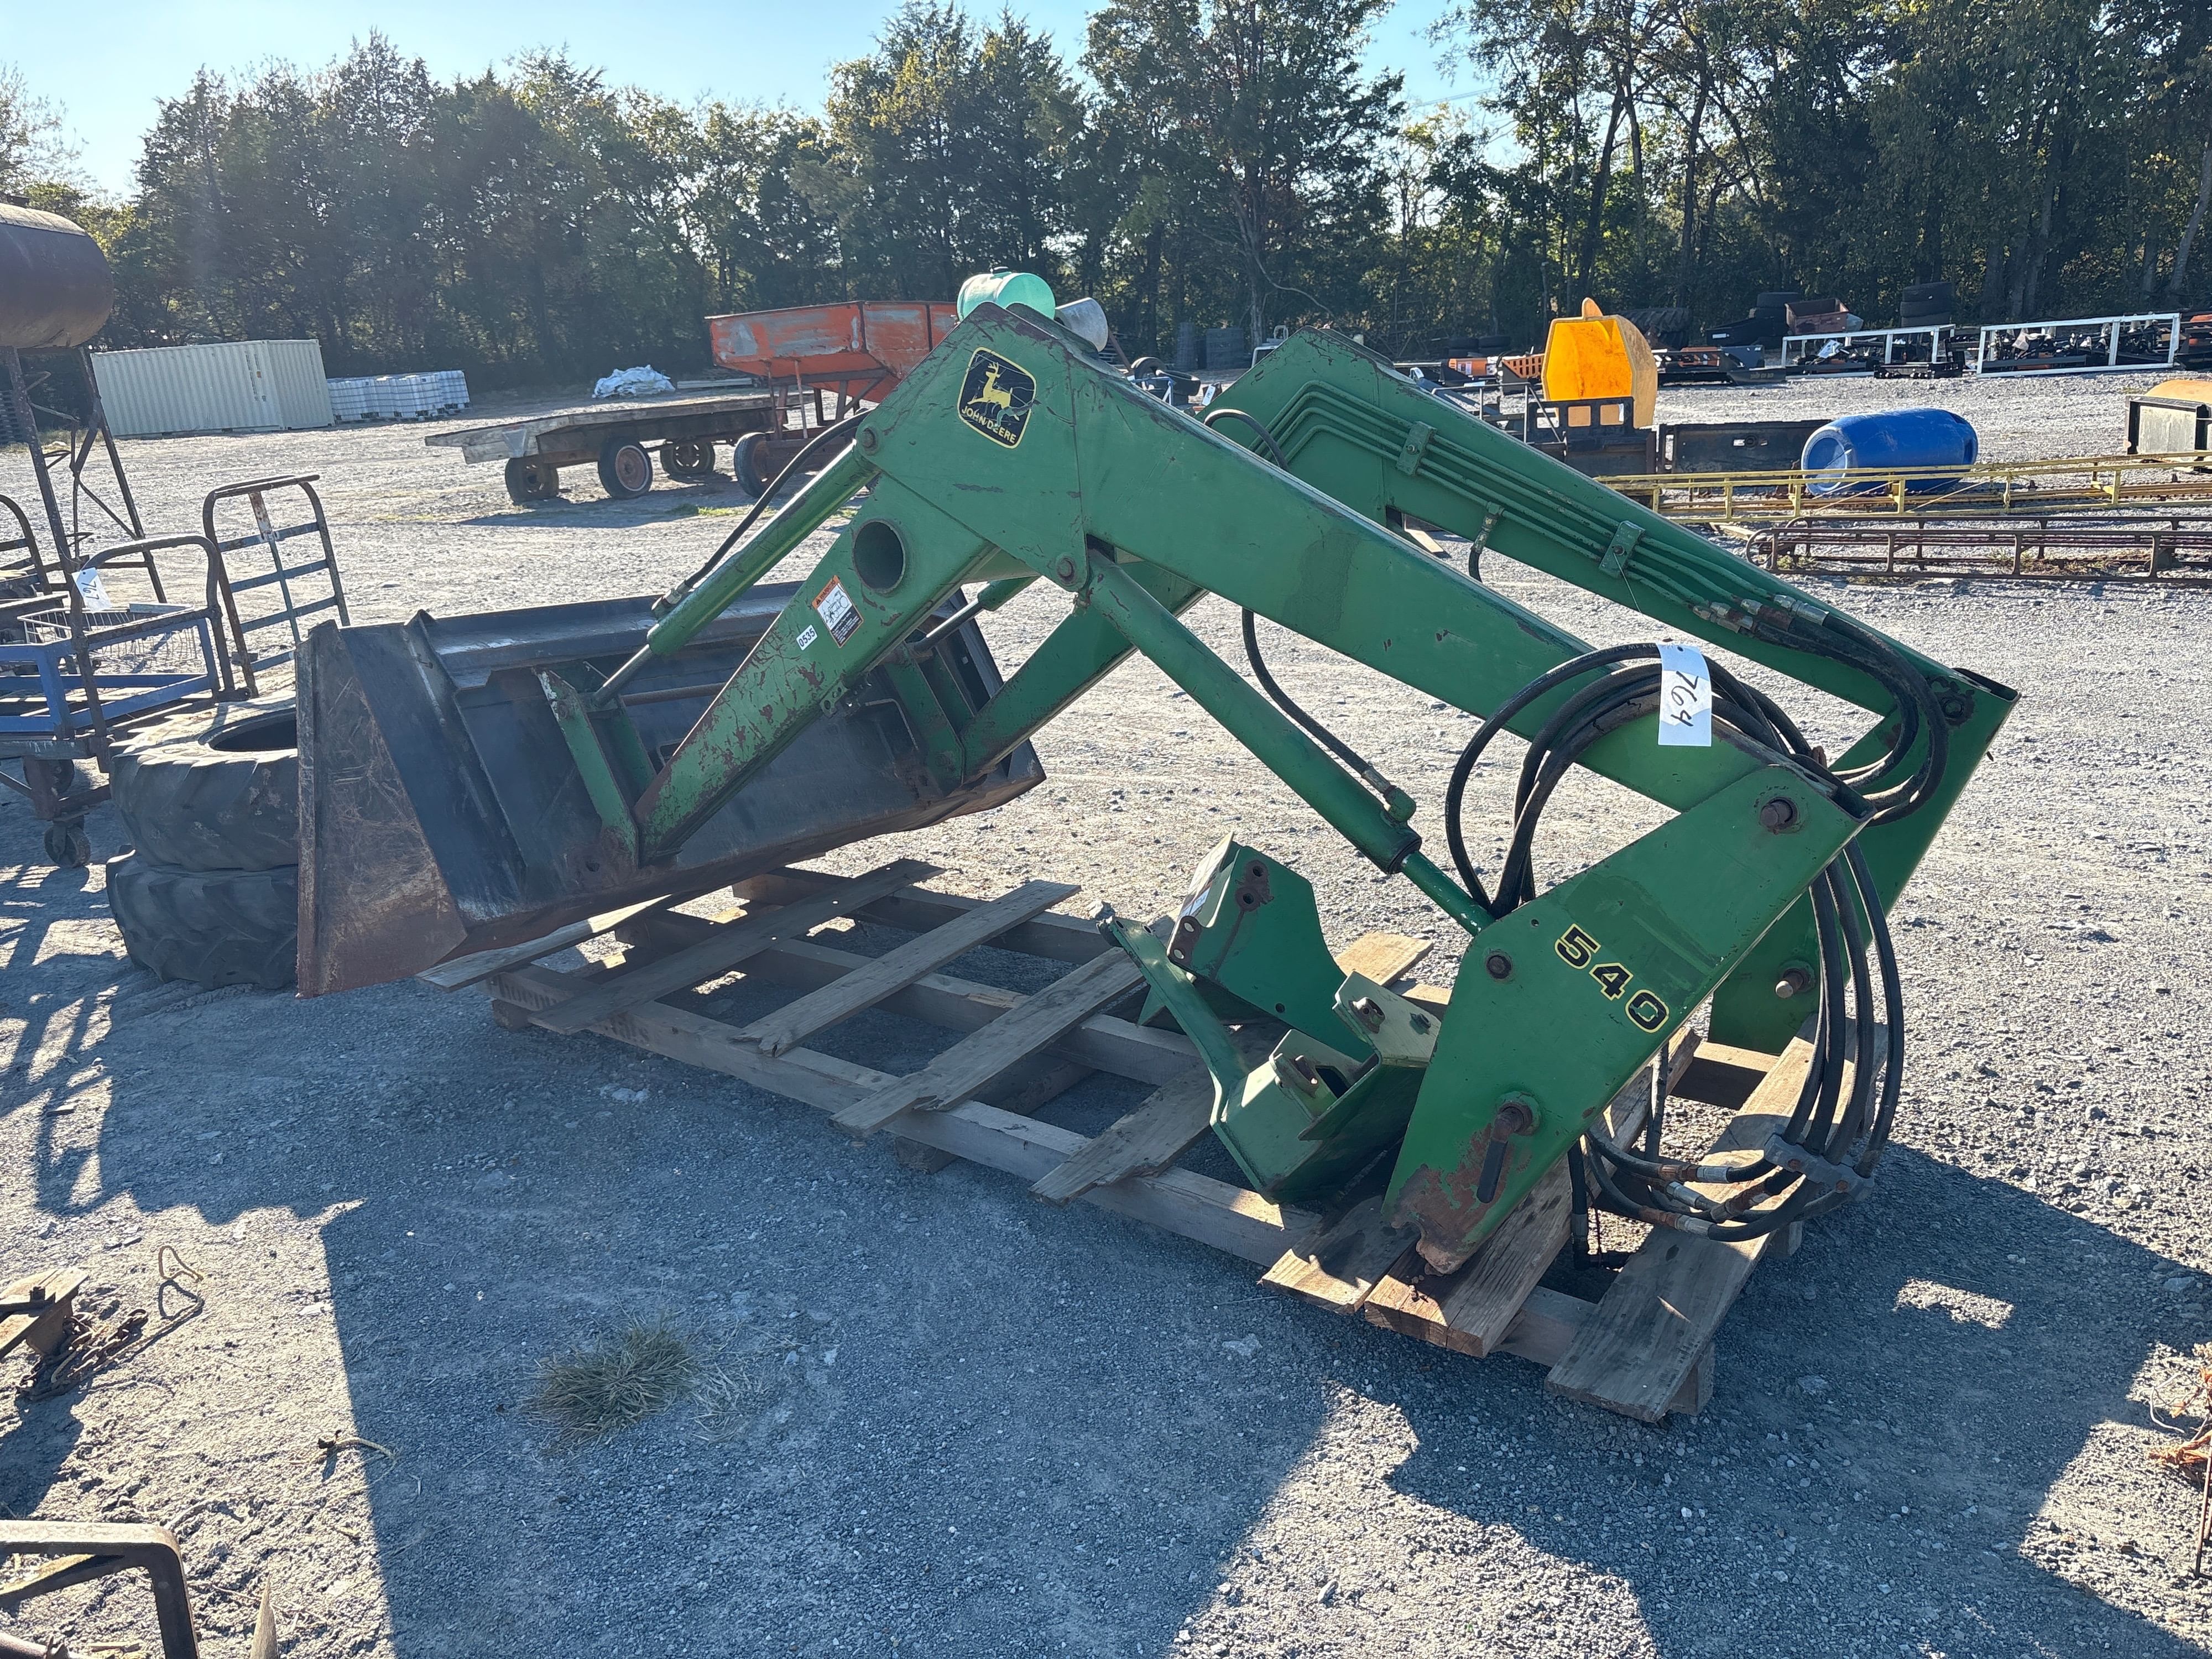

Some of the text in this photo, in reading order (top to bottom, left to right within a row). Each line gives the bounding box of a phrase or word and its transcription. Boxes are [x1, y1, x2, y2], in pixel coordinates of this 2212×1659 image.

[962, 406, 1017, 444] JOHN DEERE
[81, 581, 100, 600] 767
[798, 628, 815, 647] 0535
[1671, 671, 1699, 727] 764
[1554, 923, 1670, 1033] 540
